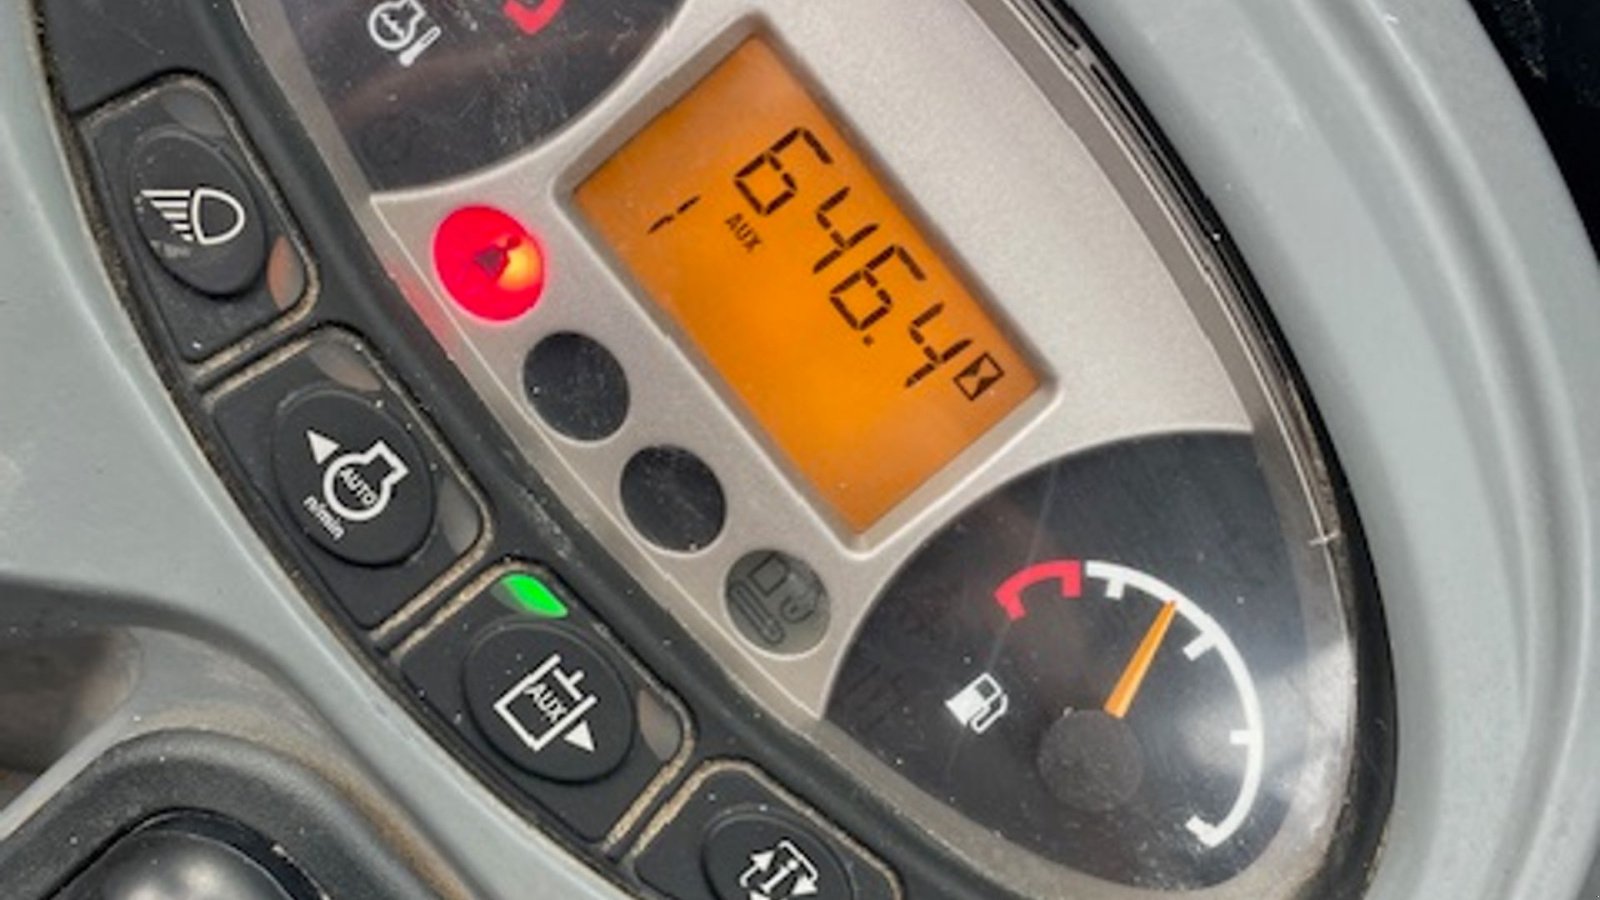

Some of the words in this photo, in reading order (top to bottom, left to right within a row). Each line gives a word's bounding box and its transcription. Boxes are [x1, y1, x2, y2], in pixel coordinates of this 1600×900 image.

[724, 212, 763, 253] AUX
[339, 467, 378, 505] AUTO
[303, 496, 345, 540] n/min
[524, 682, 568, 722] AUX
